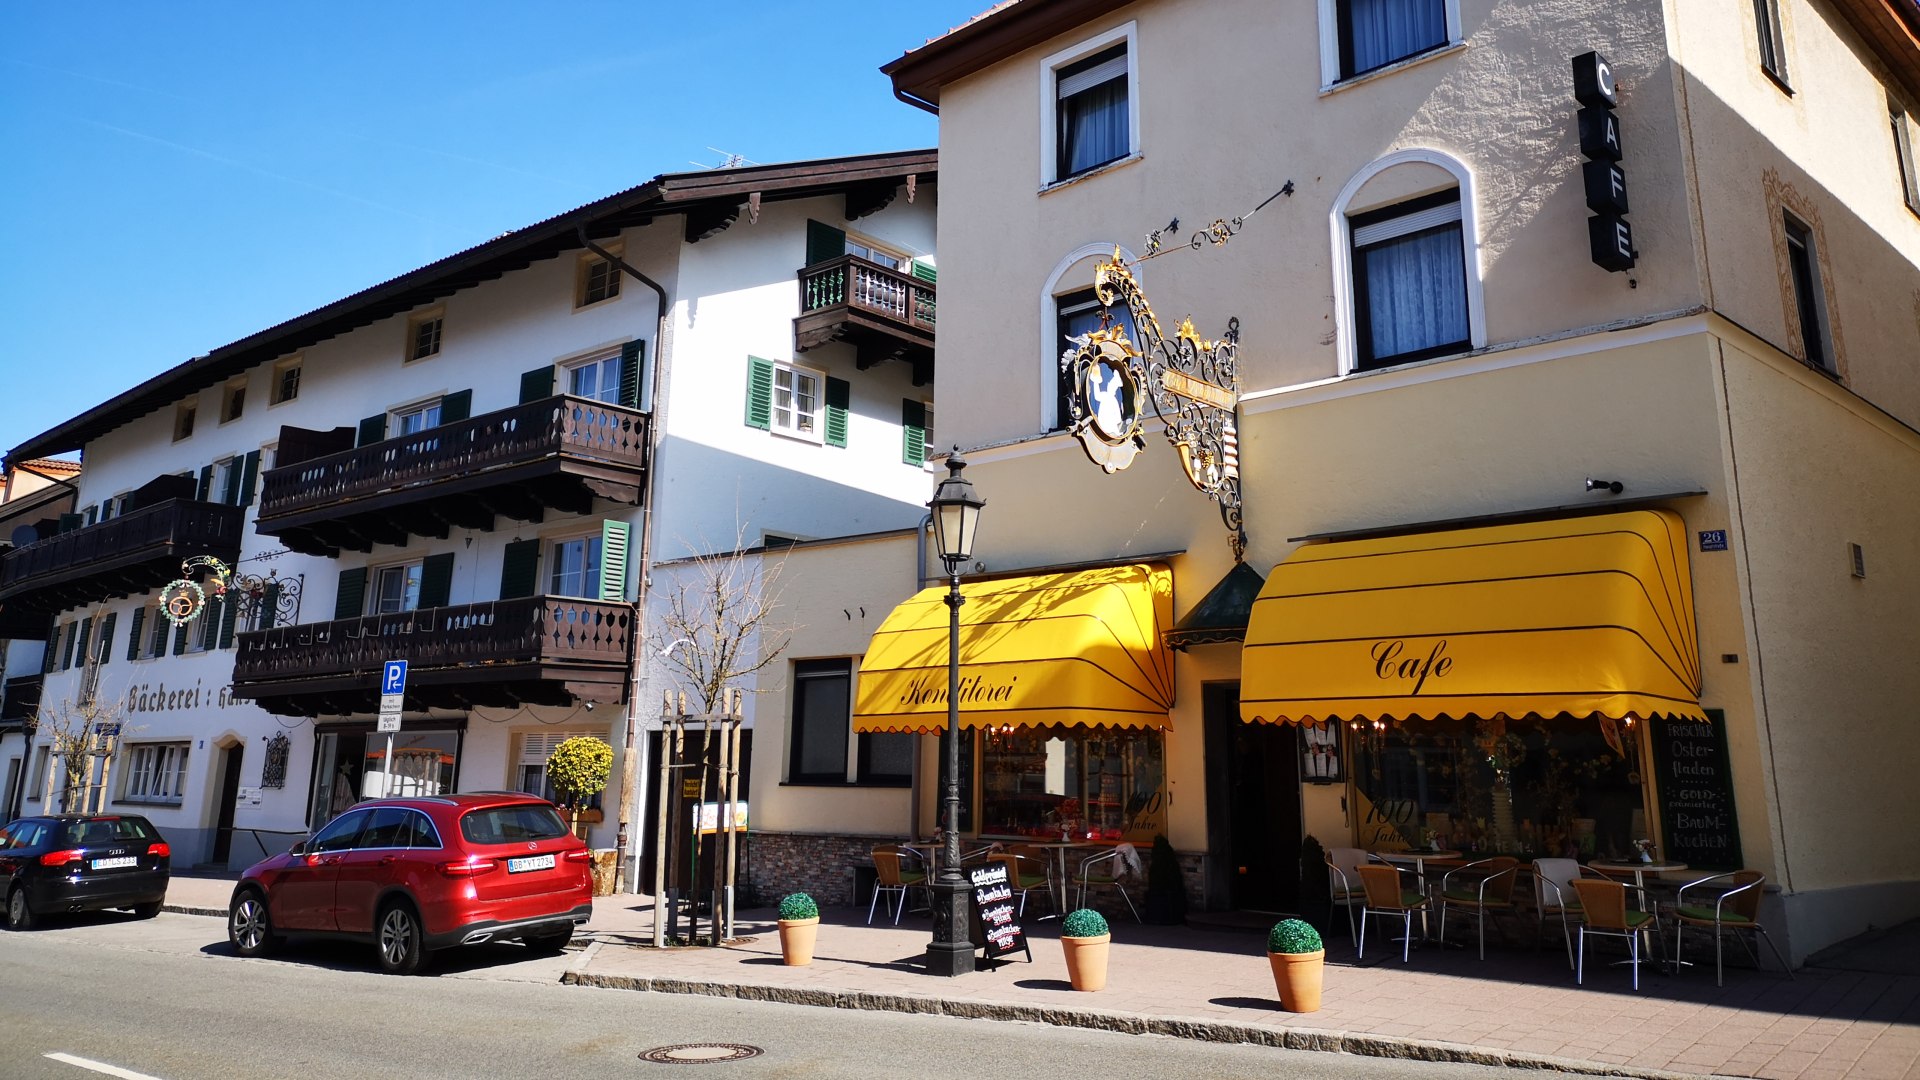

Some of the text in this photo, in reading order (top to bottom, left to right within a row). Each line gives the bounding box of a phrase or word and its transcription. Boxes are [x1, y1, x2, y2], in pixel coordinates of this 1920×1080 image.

[1598, 62, 1631, 259] CAFE
[1703, 531, 1721, 544] 26
[387, 665, 402, 690] P
[1370, 639, 1454, 696] Cafe
[127, 677, 202, 714] Bäckerei
[1671, 740, 1714, 758] Oster-
[1672, 760, 1715, 778] fladen
[1365, 799, 1414, 825] 100
